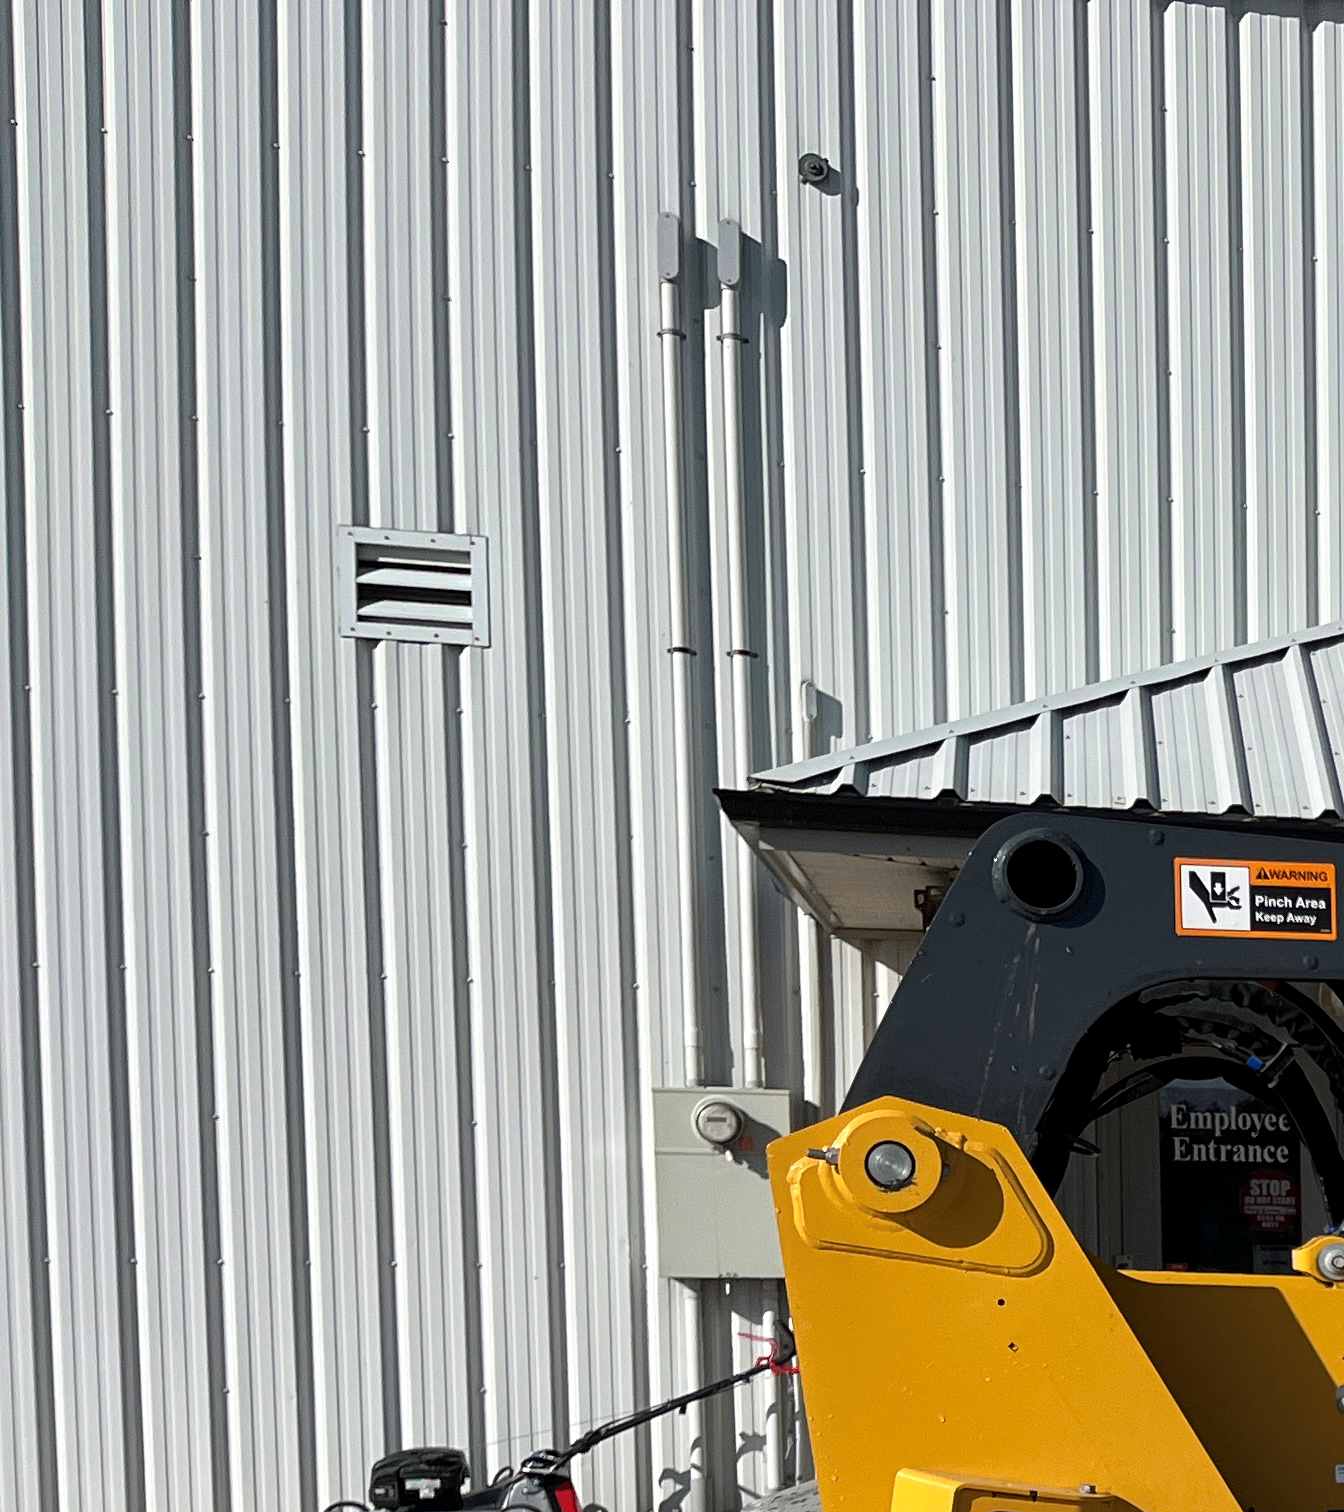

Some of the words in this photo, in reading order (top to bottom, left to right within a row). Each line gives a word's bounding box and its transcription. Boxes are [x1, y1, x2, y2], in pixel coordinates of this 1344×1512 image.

[1269, 869, 1328, 882] WARNING
[1255, 895, 1292, 908] Pinch
[1296, 897, 1326, 910] Area
[1255, 912, 1284, 925] Keep
[1287, 913, 1317, 926] Away
[1170, 1104, 1291, 1138] Employee
[1173, 1136, 1289, 1163] Entrance
[1250, 1179, 1291, 1196] STOP
